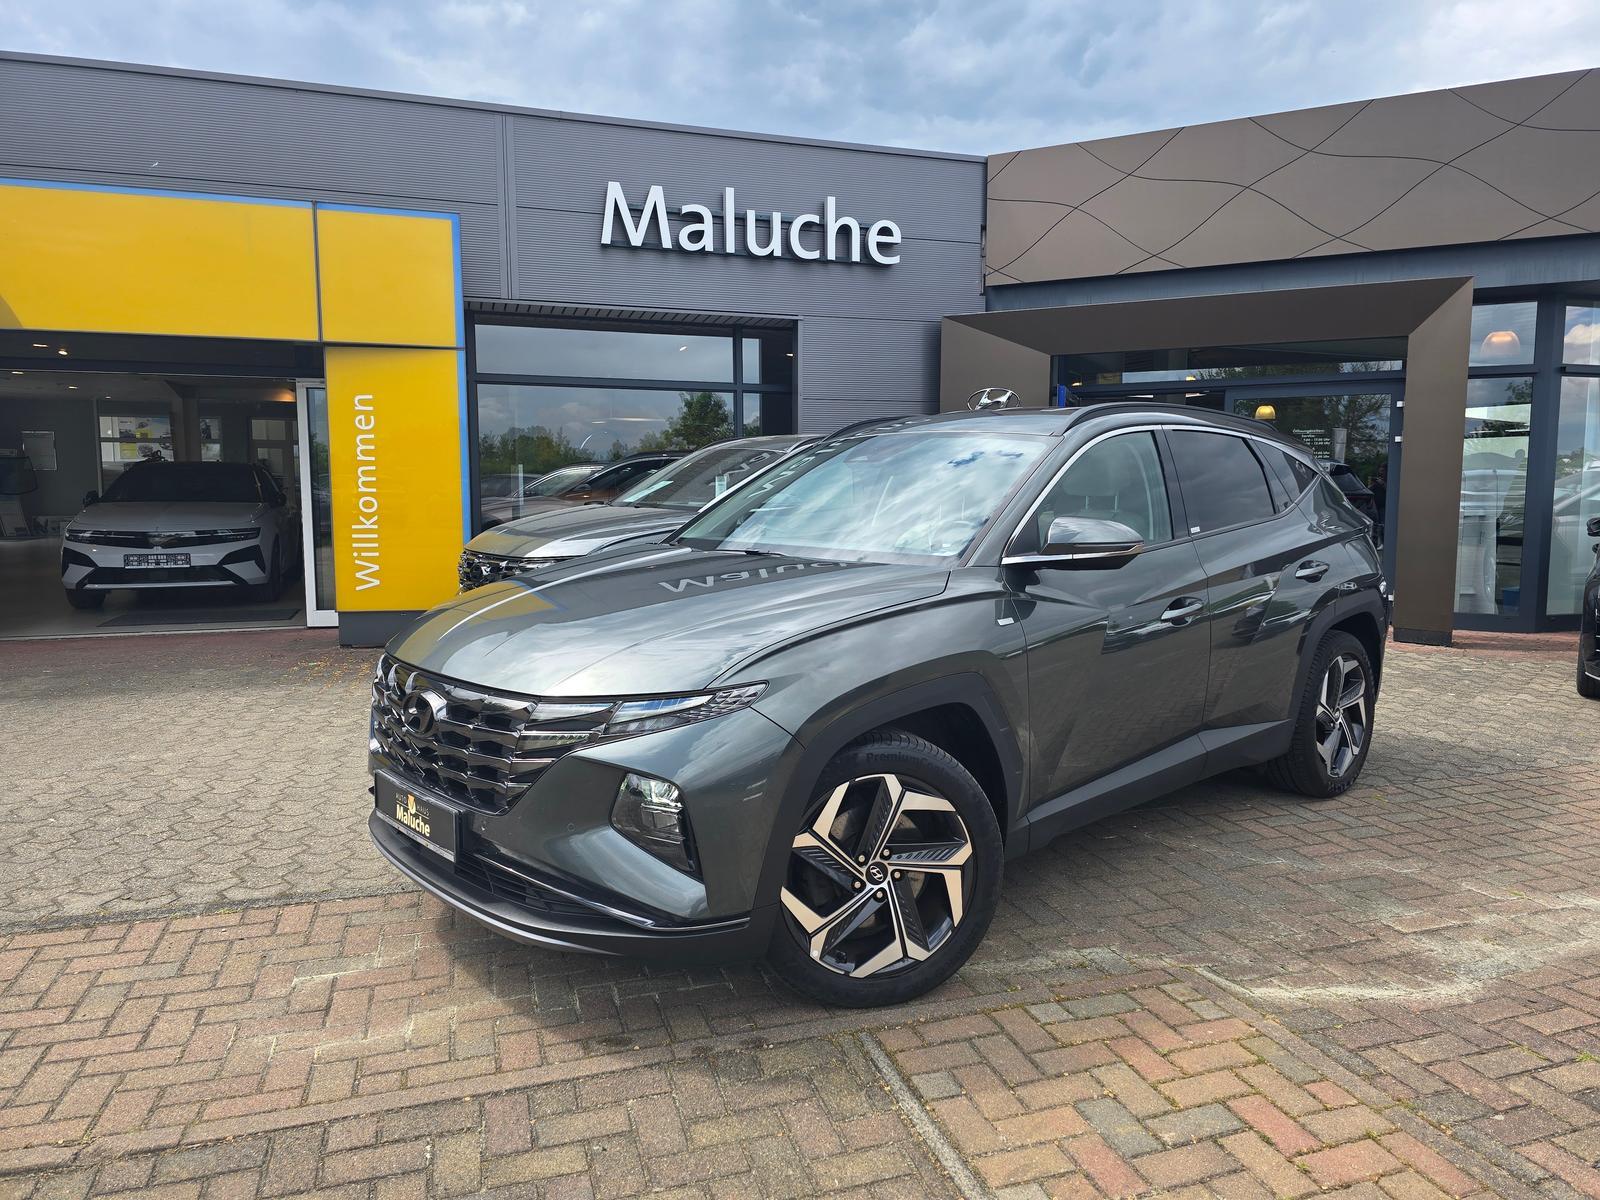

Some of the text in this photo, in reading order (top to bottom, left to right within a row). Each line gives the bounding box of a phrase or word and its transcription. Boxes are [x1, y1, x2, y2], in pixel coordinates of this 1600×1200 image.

[601, 181, 902, 265] Maluche
[351, 394, 381, 591] Willkommen
[396, 804, 431, 837] Maluche
